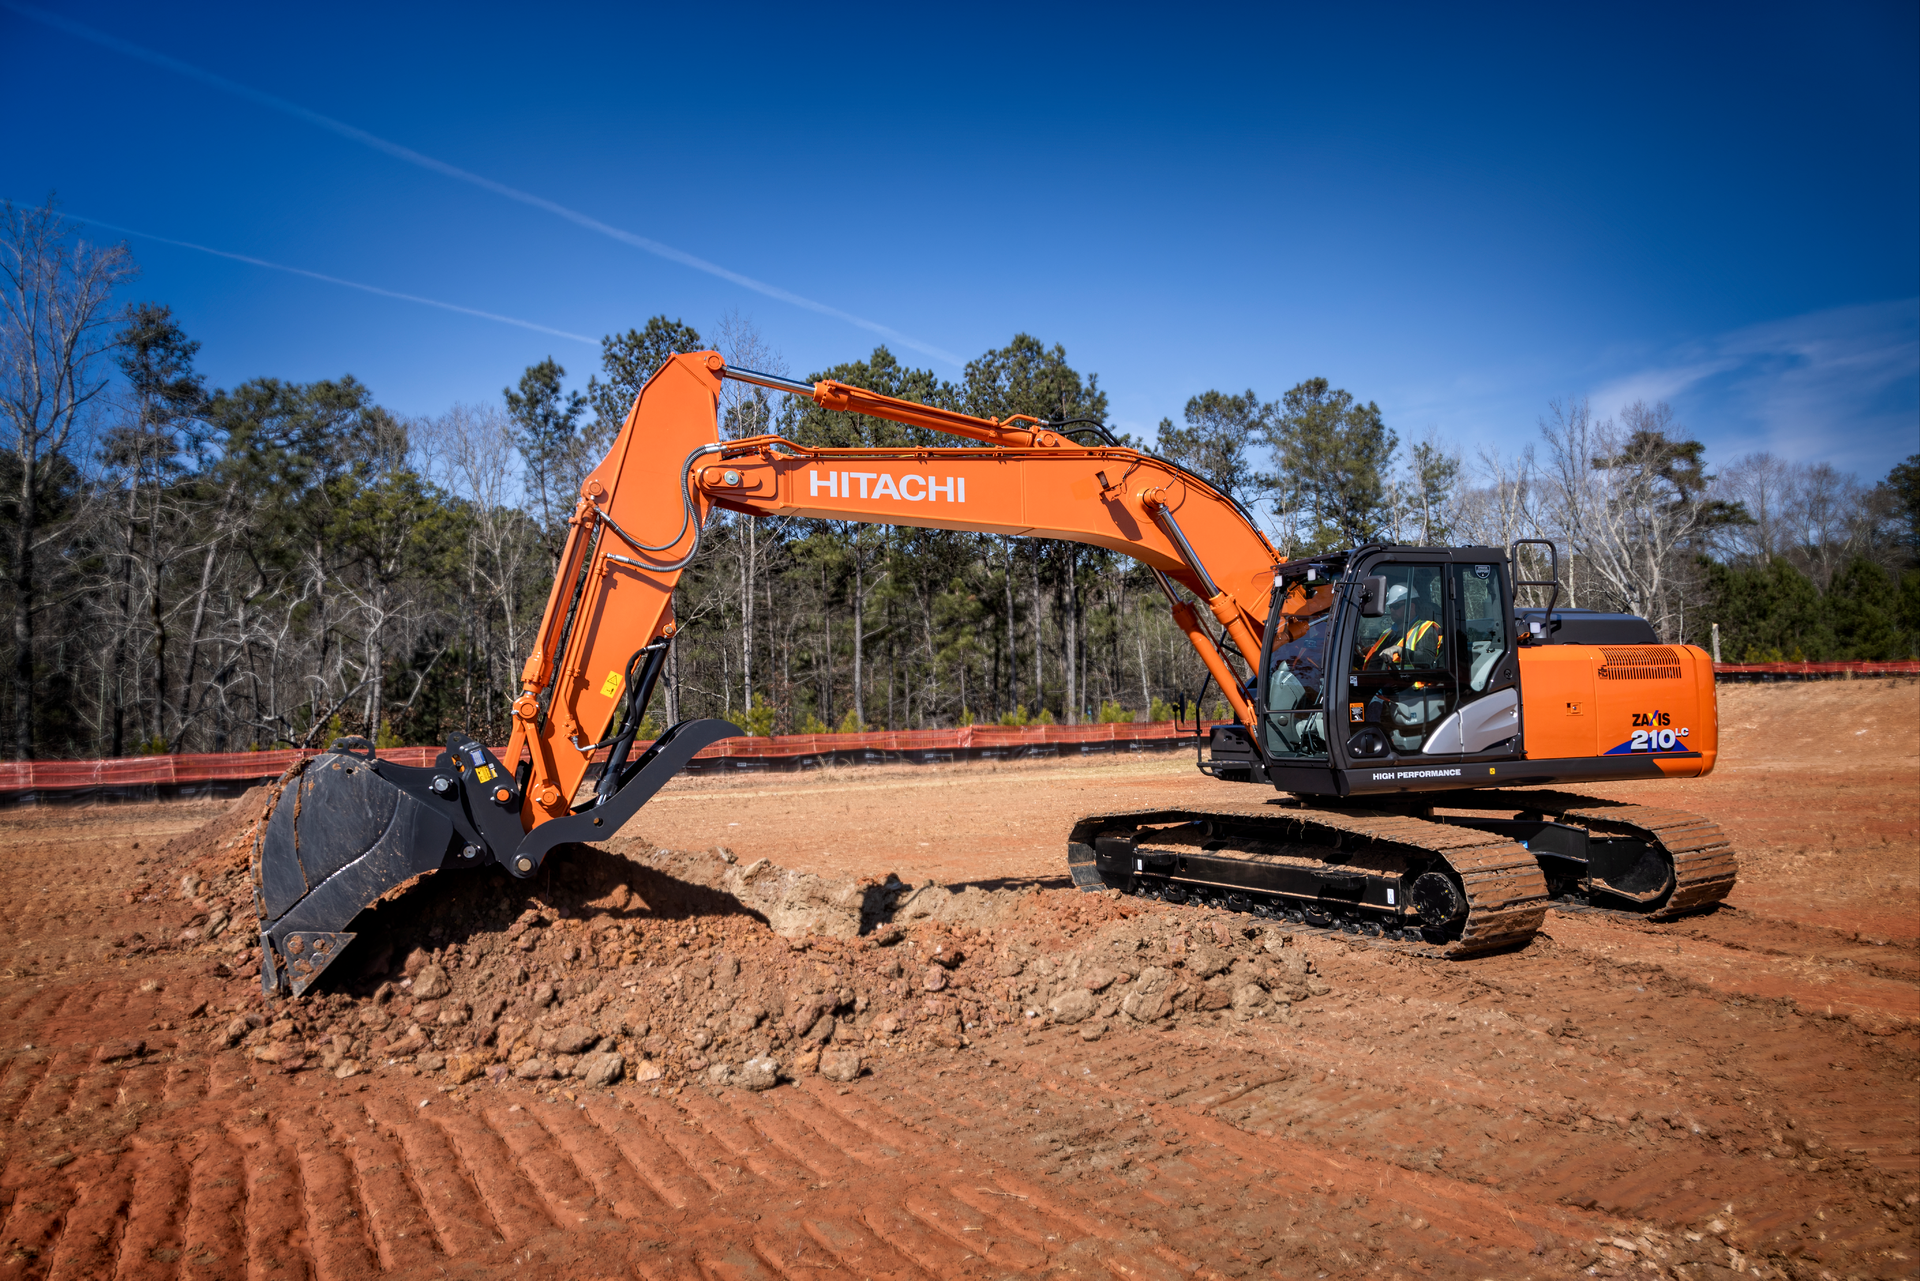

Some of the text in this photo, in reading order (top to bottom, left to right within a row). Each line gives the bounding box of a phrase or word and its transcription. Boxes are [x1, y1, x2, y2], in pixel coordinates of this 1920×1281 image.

[810, 470, 965, 502] HITACHI
[1632, 710, 1671, 726] ZAXIS
[1372, 768, 1462, 781] HIGH PERFORMANCE
